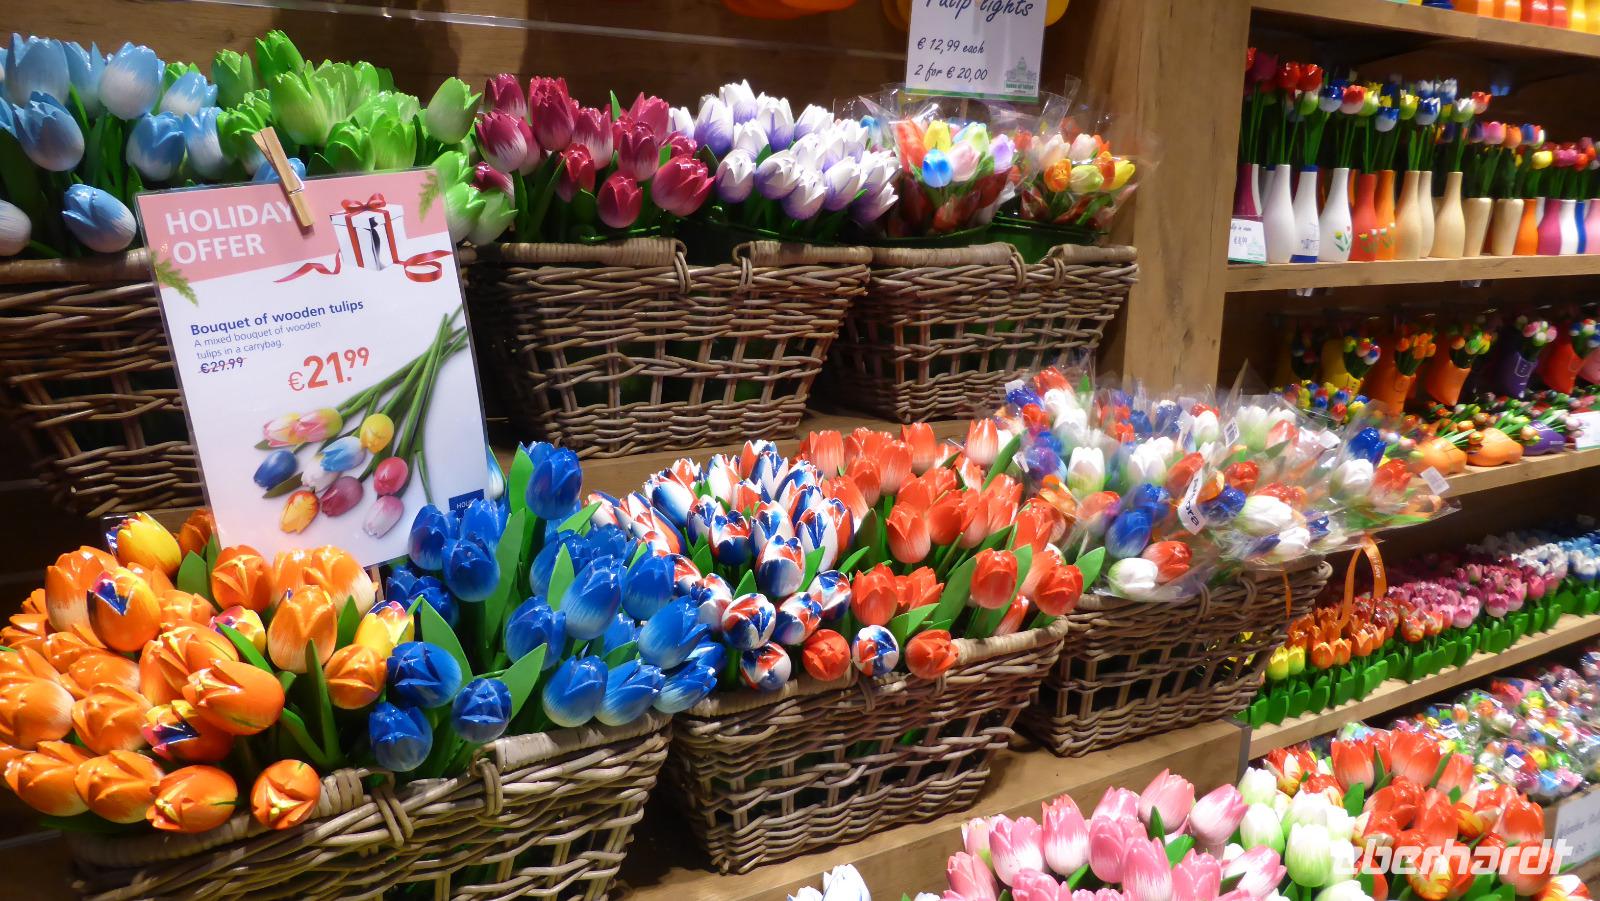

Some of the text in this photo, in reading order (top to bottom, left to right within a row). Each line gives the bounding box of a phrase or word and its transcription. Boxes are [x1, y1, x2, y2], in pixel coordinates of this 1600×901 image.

[917, 37, 985, 54] € 12,99 each
[914, 62, 988, 83] 2 for € 20,00
[165, 201, 294, 235] HOLIDAY
[173, 234, 266, 264] OFFER
[190, 300, 364, 336] Bouquet of wooden tulips
[194, 320, 321, 348] A mixed bouquet of wooden
[196, 349, 223, 360] tulips
[224, 347, 233, 356] in
[243, 339, 285, 352] carrybag.
[200, 356, 244, 374] €29.99
